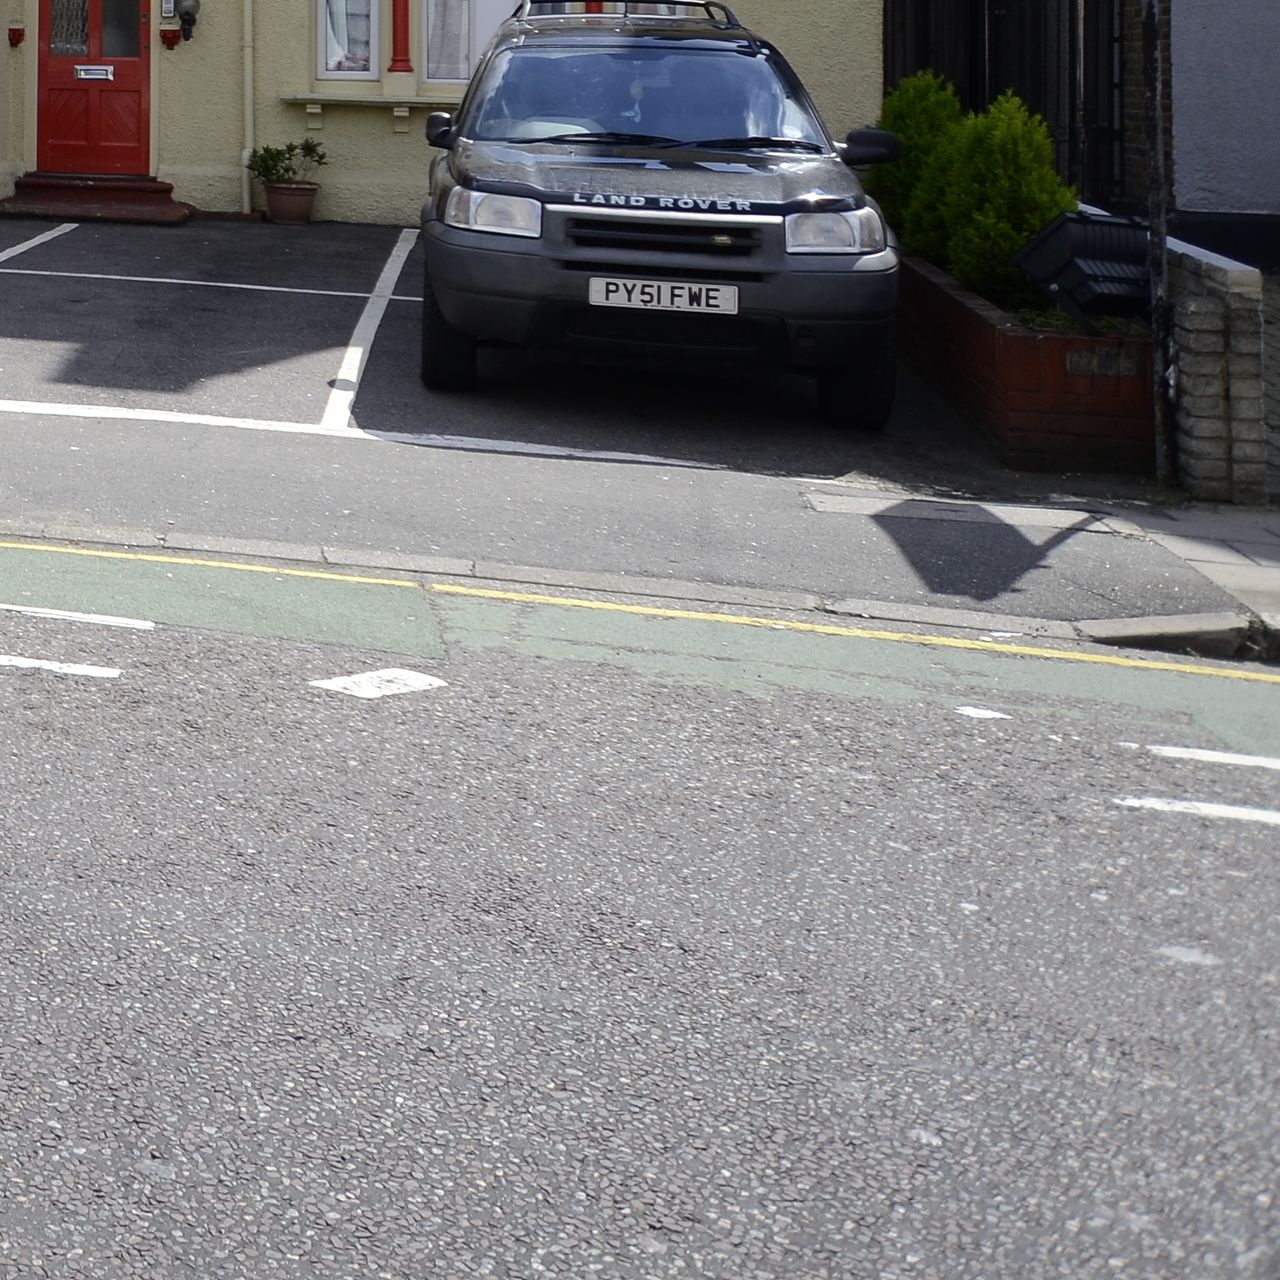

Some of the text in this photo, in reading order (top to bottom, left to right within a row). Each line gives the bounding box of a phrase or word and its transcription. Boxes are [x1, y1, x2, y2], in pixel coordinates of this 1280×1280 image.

[573, 193, 752, 211] LAND ROVER
[604, 281, 721, 309] PY51 FWE
